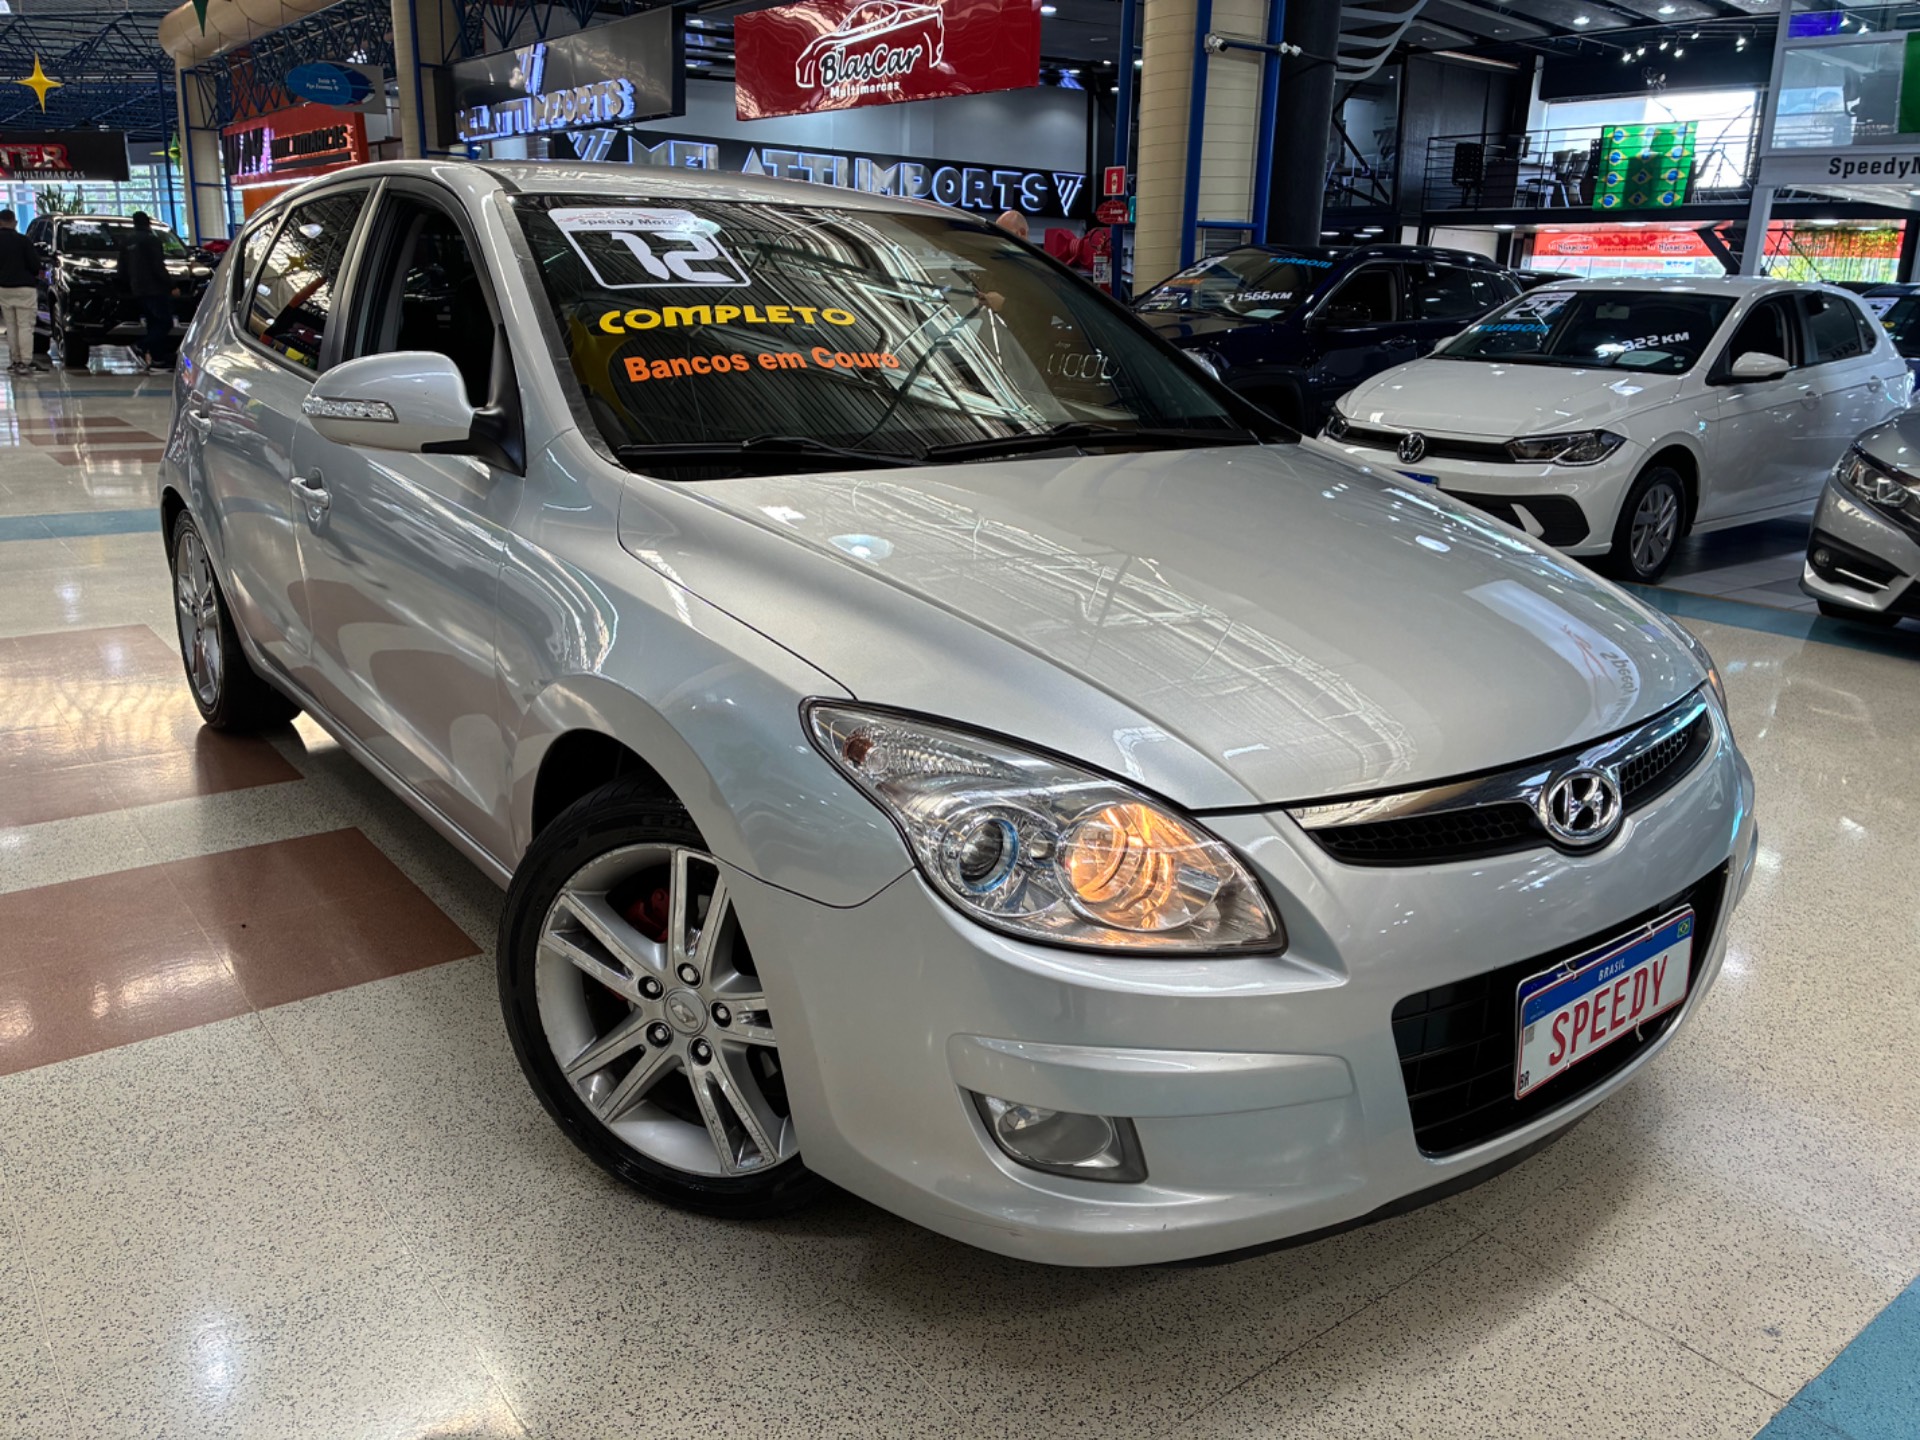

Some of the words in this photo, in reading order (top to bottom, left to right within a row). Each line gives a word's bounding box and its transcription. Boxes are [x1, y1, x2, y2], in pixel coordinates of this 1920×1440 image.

[819, 43, 922, 87] BlasCar
[14, 170, 86, 180] MULTIMARCAS
[611, 231, 736, 282] 12
[599, 305, 856, 334] COMPLETO
[1661, 331, 1690, 344] KM
[624, 353, 750, 383] Bancos
[757, 351, 807, 370] em
[811, 346, 900, 369] Couro
[1598, 958, 1626, 982] BRASIL
[1549, 954, 1668, 1066] SPEEDY
